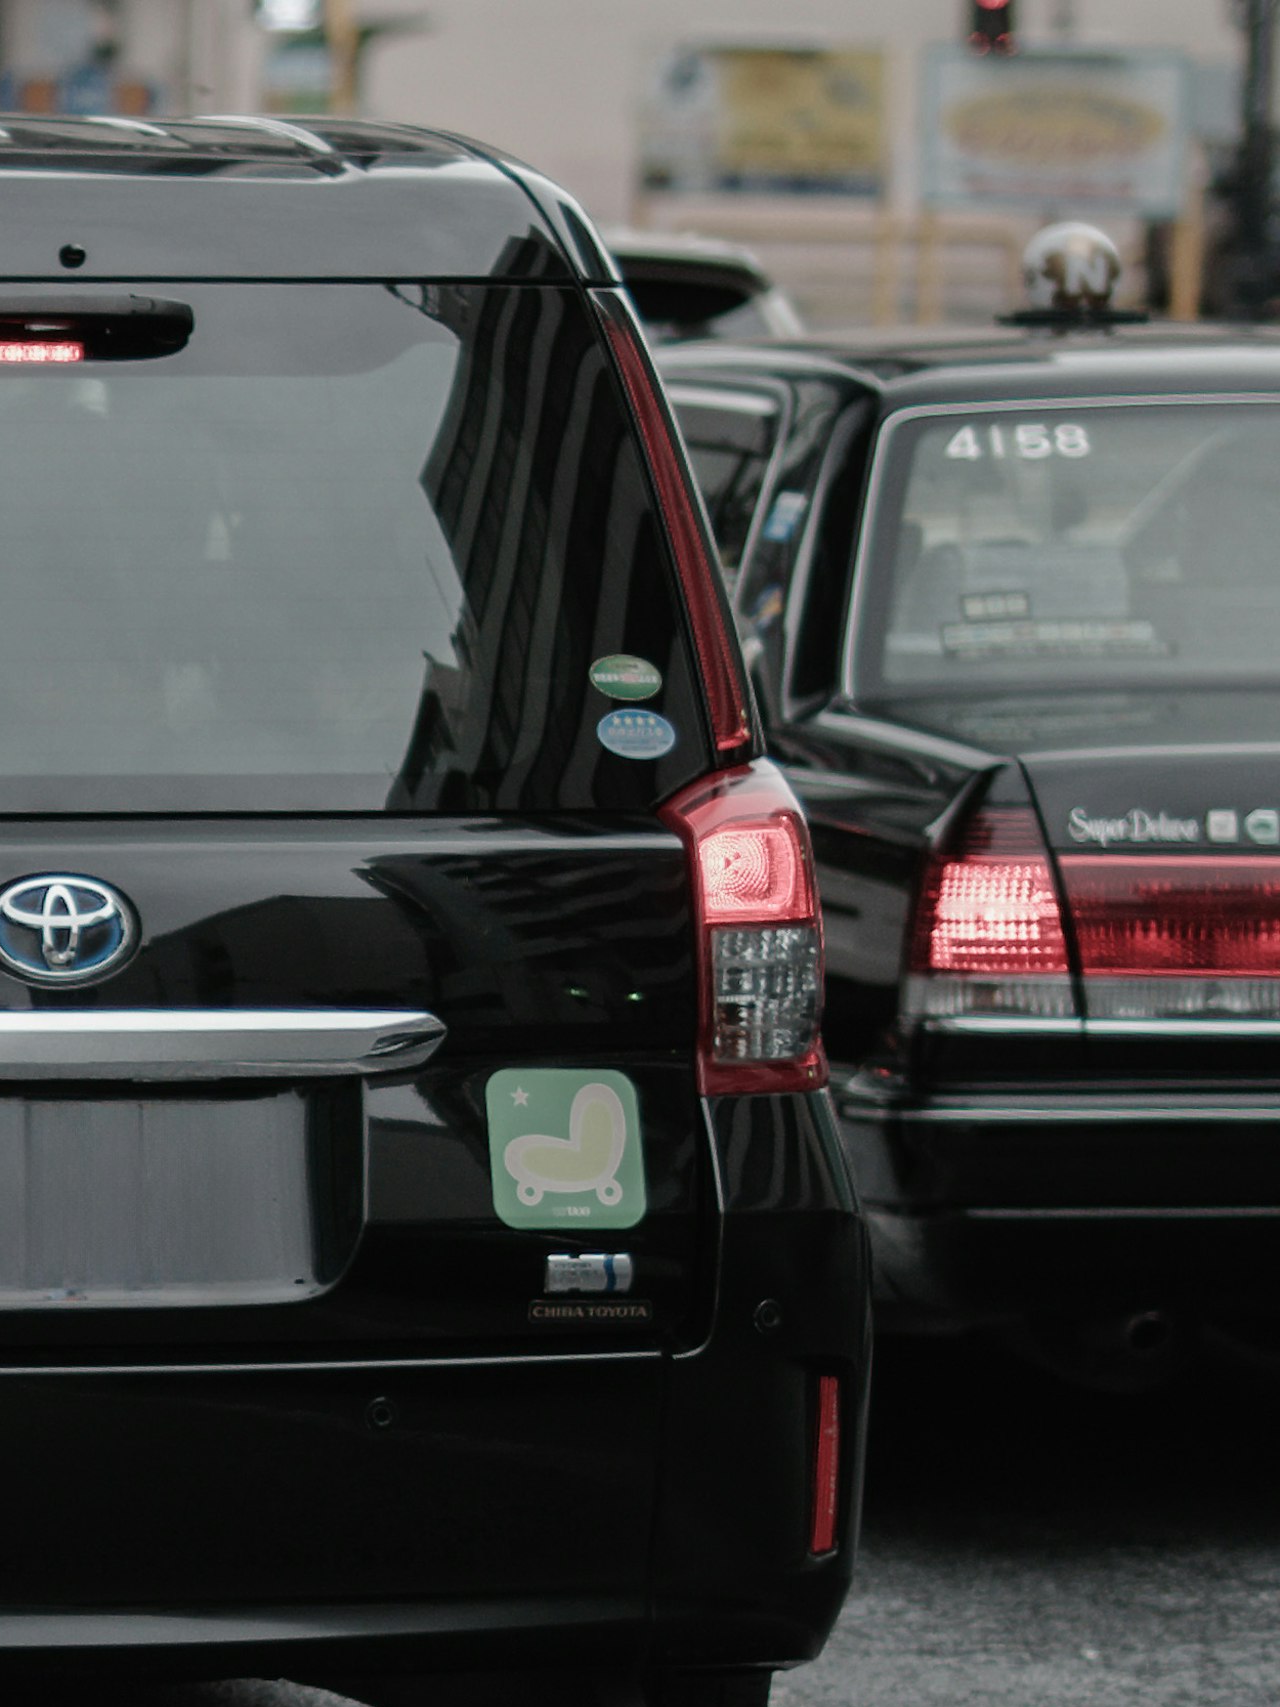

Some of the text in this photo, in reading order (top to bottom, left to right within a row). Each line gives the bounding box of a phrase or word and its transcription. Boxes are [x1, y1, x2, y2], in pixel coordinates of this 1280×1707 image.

[945, 423, 1091, 461] 4158
[1068, 806, 1200, 848] Super Deluxe
[532, 1305, 648, 1318] CHIBA TOYOTA
